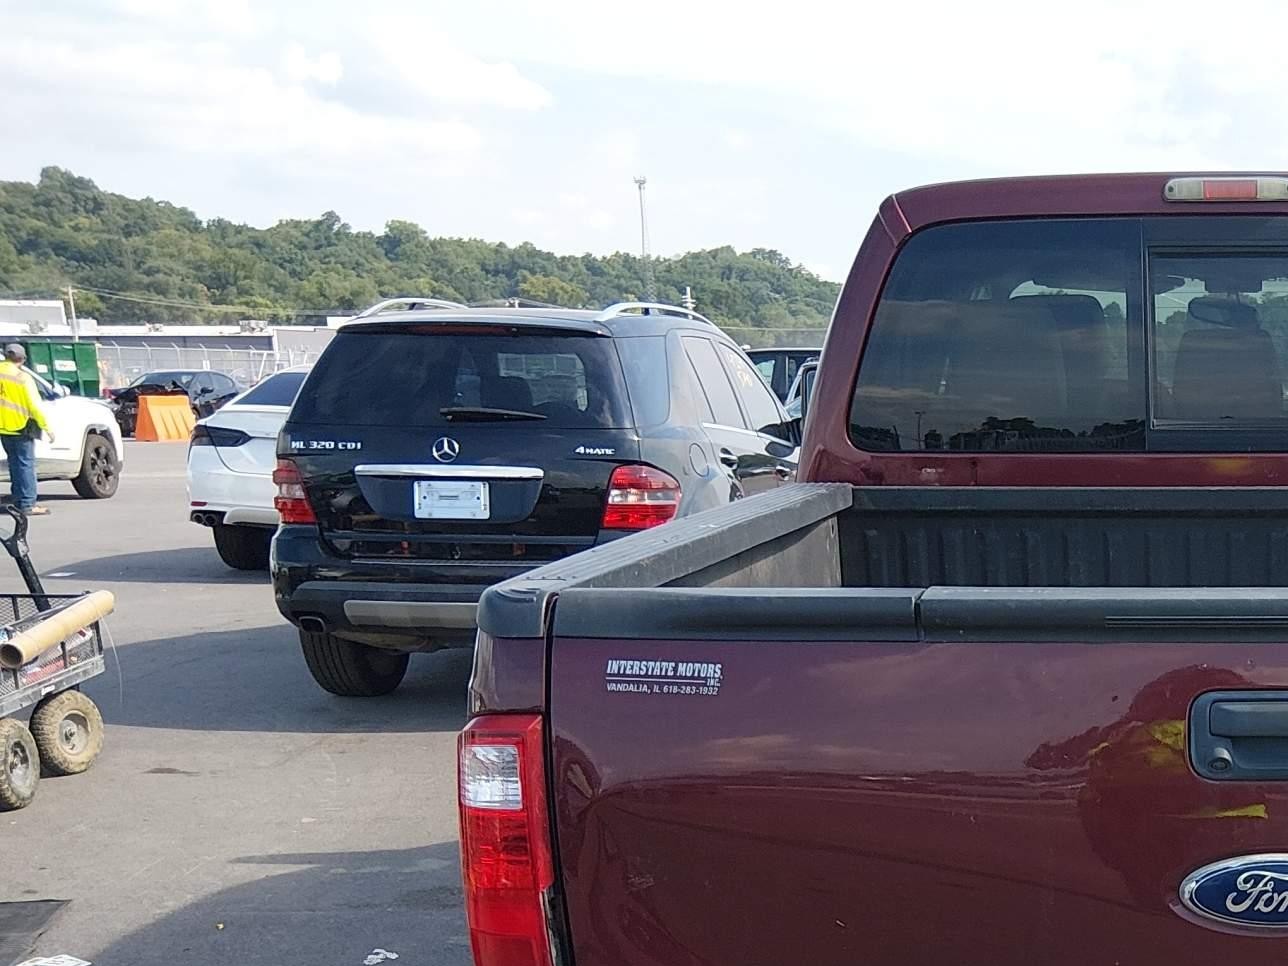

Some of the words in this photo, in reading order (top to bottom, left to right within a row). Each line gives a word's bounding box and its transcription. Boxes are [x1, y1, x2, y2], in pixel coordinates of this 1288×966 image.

[309, 441, 335, 449] 320
[338, 442, 362, 450] CDI
[606, 659, 675, 676] INTERSTATE
[606, 682, 651, 694] VANDALIA,
[653, 685, 661, 693] IL
[663, 684, 719, 696] 618-283-1932
